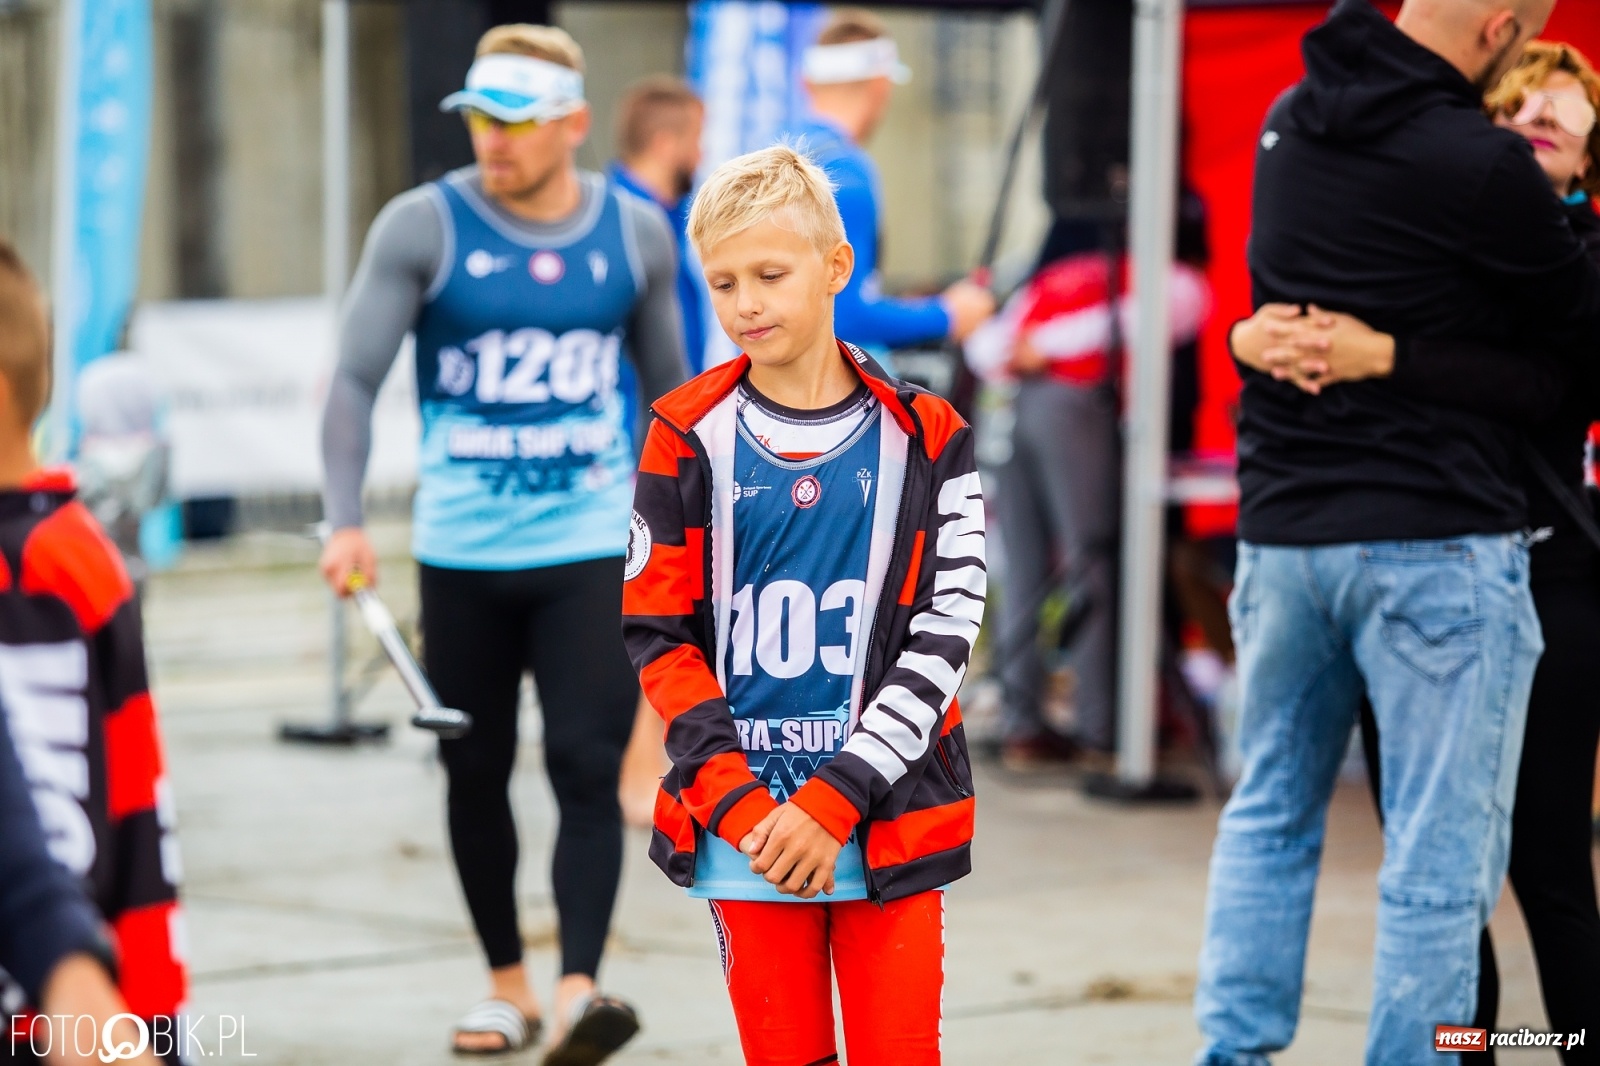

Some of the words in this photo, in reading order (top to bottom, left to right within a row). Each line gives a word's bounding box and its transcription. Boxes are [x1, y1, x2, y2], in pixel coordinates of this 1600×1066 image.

[466, 327, 604, 404] 120
[743, 490, 758, 498] SUP
[730, 579, 865, 678] 103
[781, 719, 840, 753] SUP
